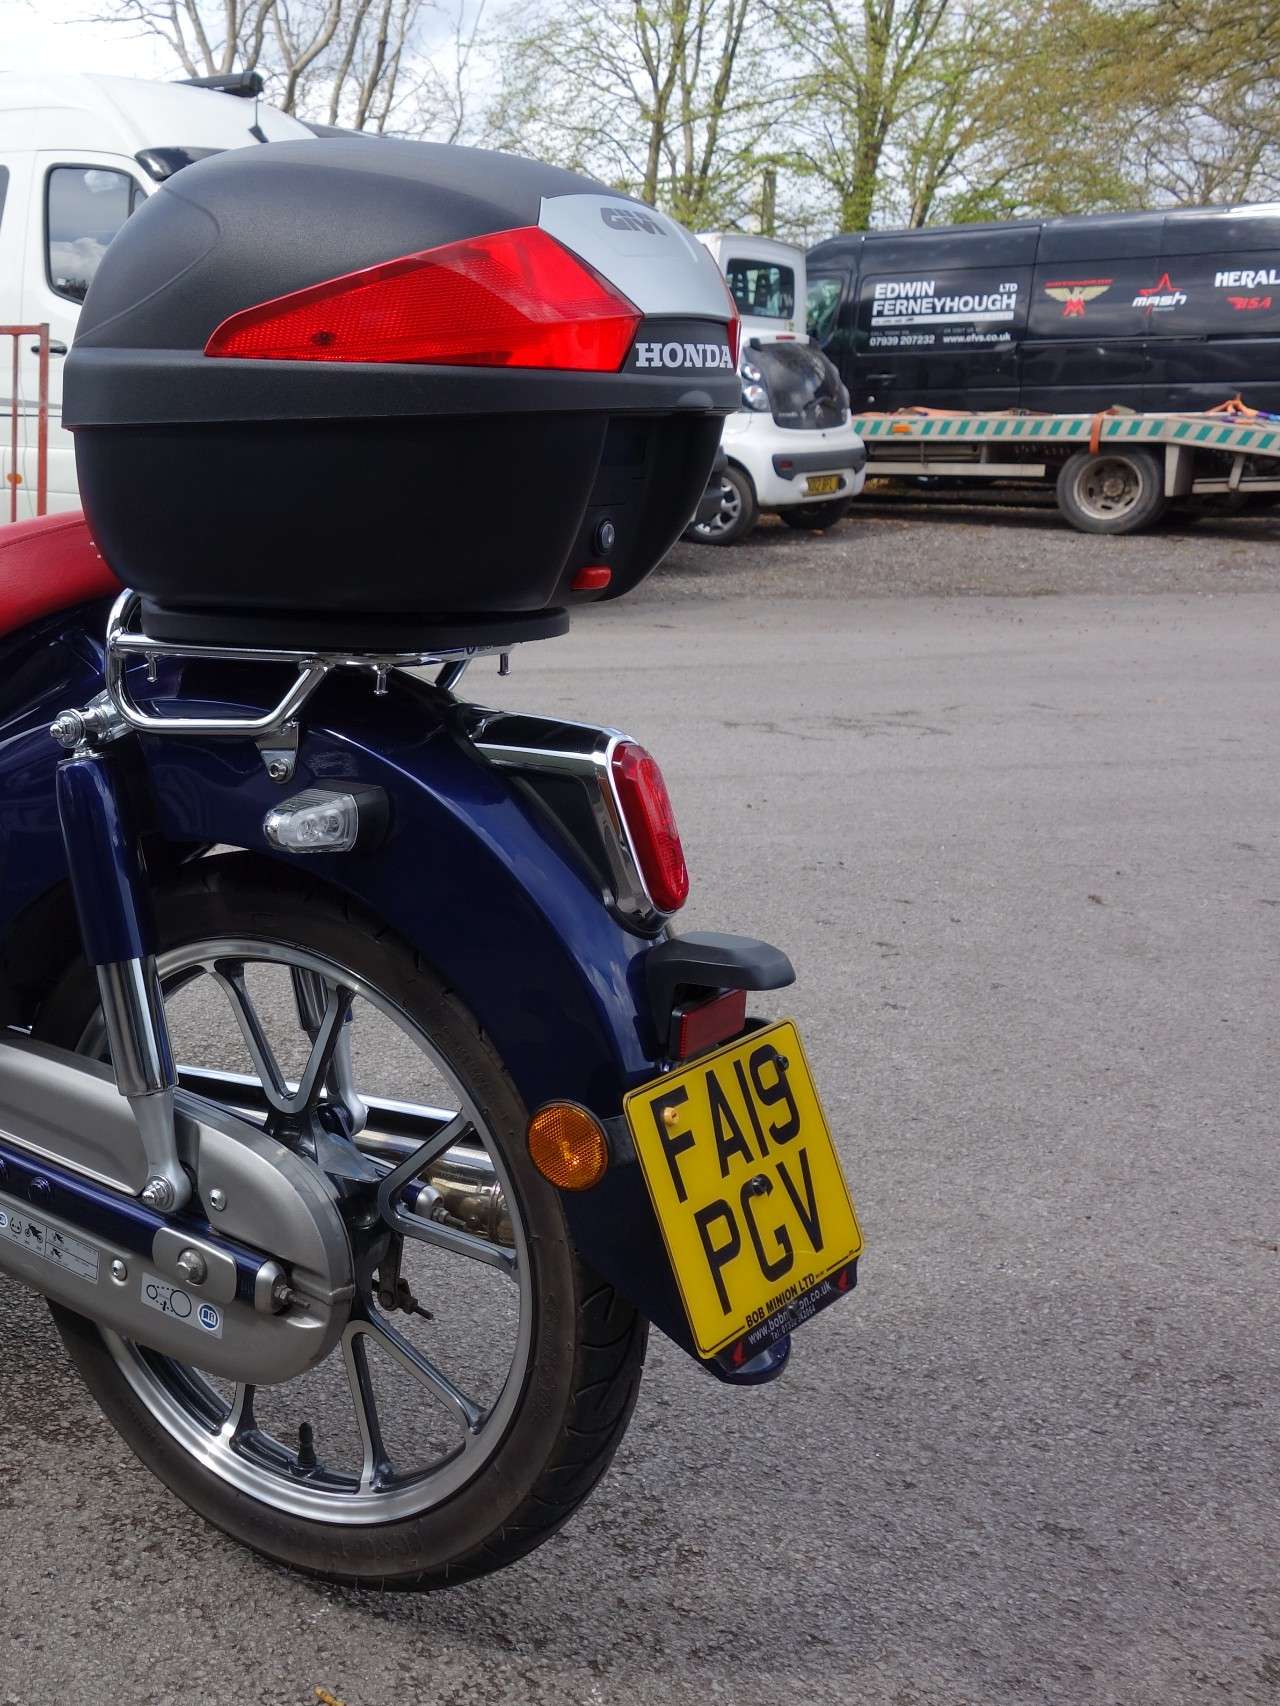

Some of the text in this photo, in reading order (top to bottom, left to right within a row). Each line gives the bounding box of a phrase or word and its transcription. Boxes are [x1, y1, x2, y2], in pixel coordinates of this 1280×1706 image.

[874, 281, 935, 299] EDWIN
[999, 283, 1018, 293] LTD
[872, 293, 1016, 316] FERNEYHOUGH
[635, 342, 734, 368] HONDA
[650, 1044, 800, 1203] FA19
[694, 1148, 824, 1316] PGV
[745, 1273, 815, 1328] BOB MINION LTD
